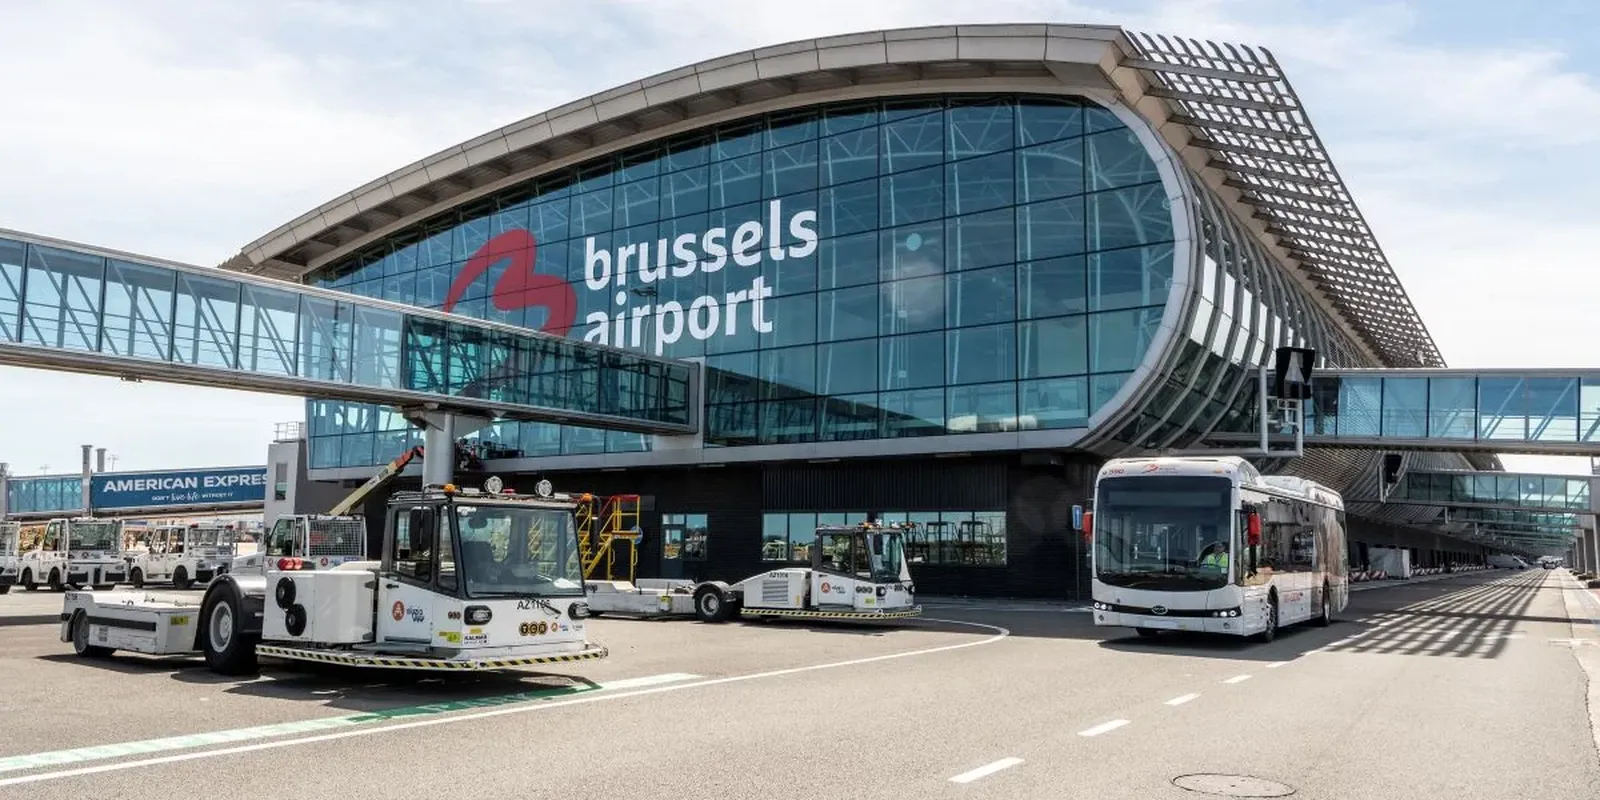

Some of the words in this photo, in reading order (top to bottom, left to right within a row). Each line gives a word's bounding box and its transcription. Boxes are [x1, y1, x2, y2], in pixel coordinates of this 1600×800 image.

[585, 200, 819, 290] brussels
[583, 276, 773, 356] airport
[103, 476, 198, 492] AMERICAN
[520, 622, 547, 635] TCR
